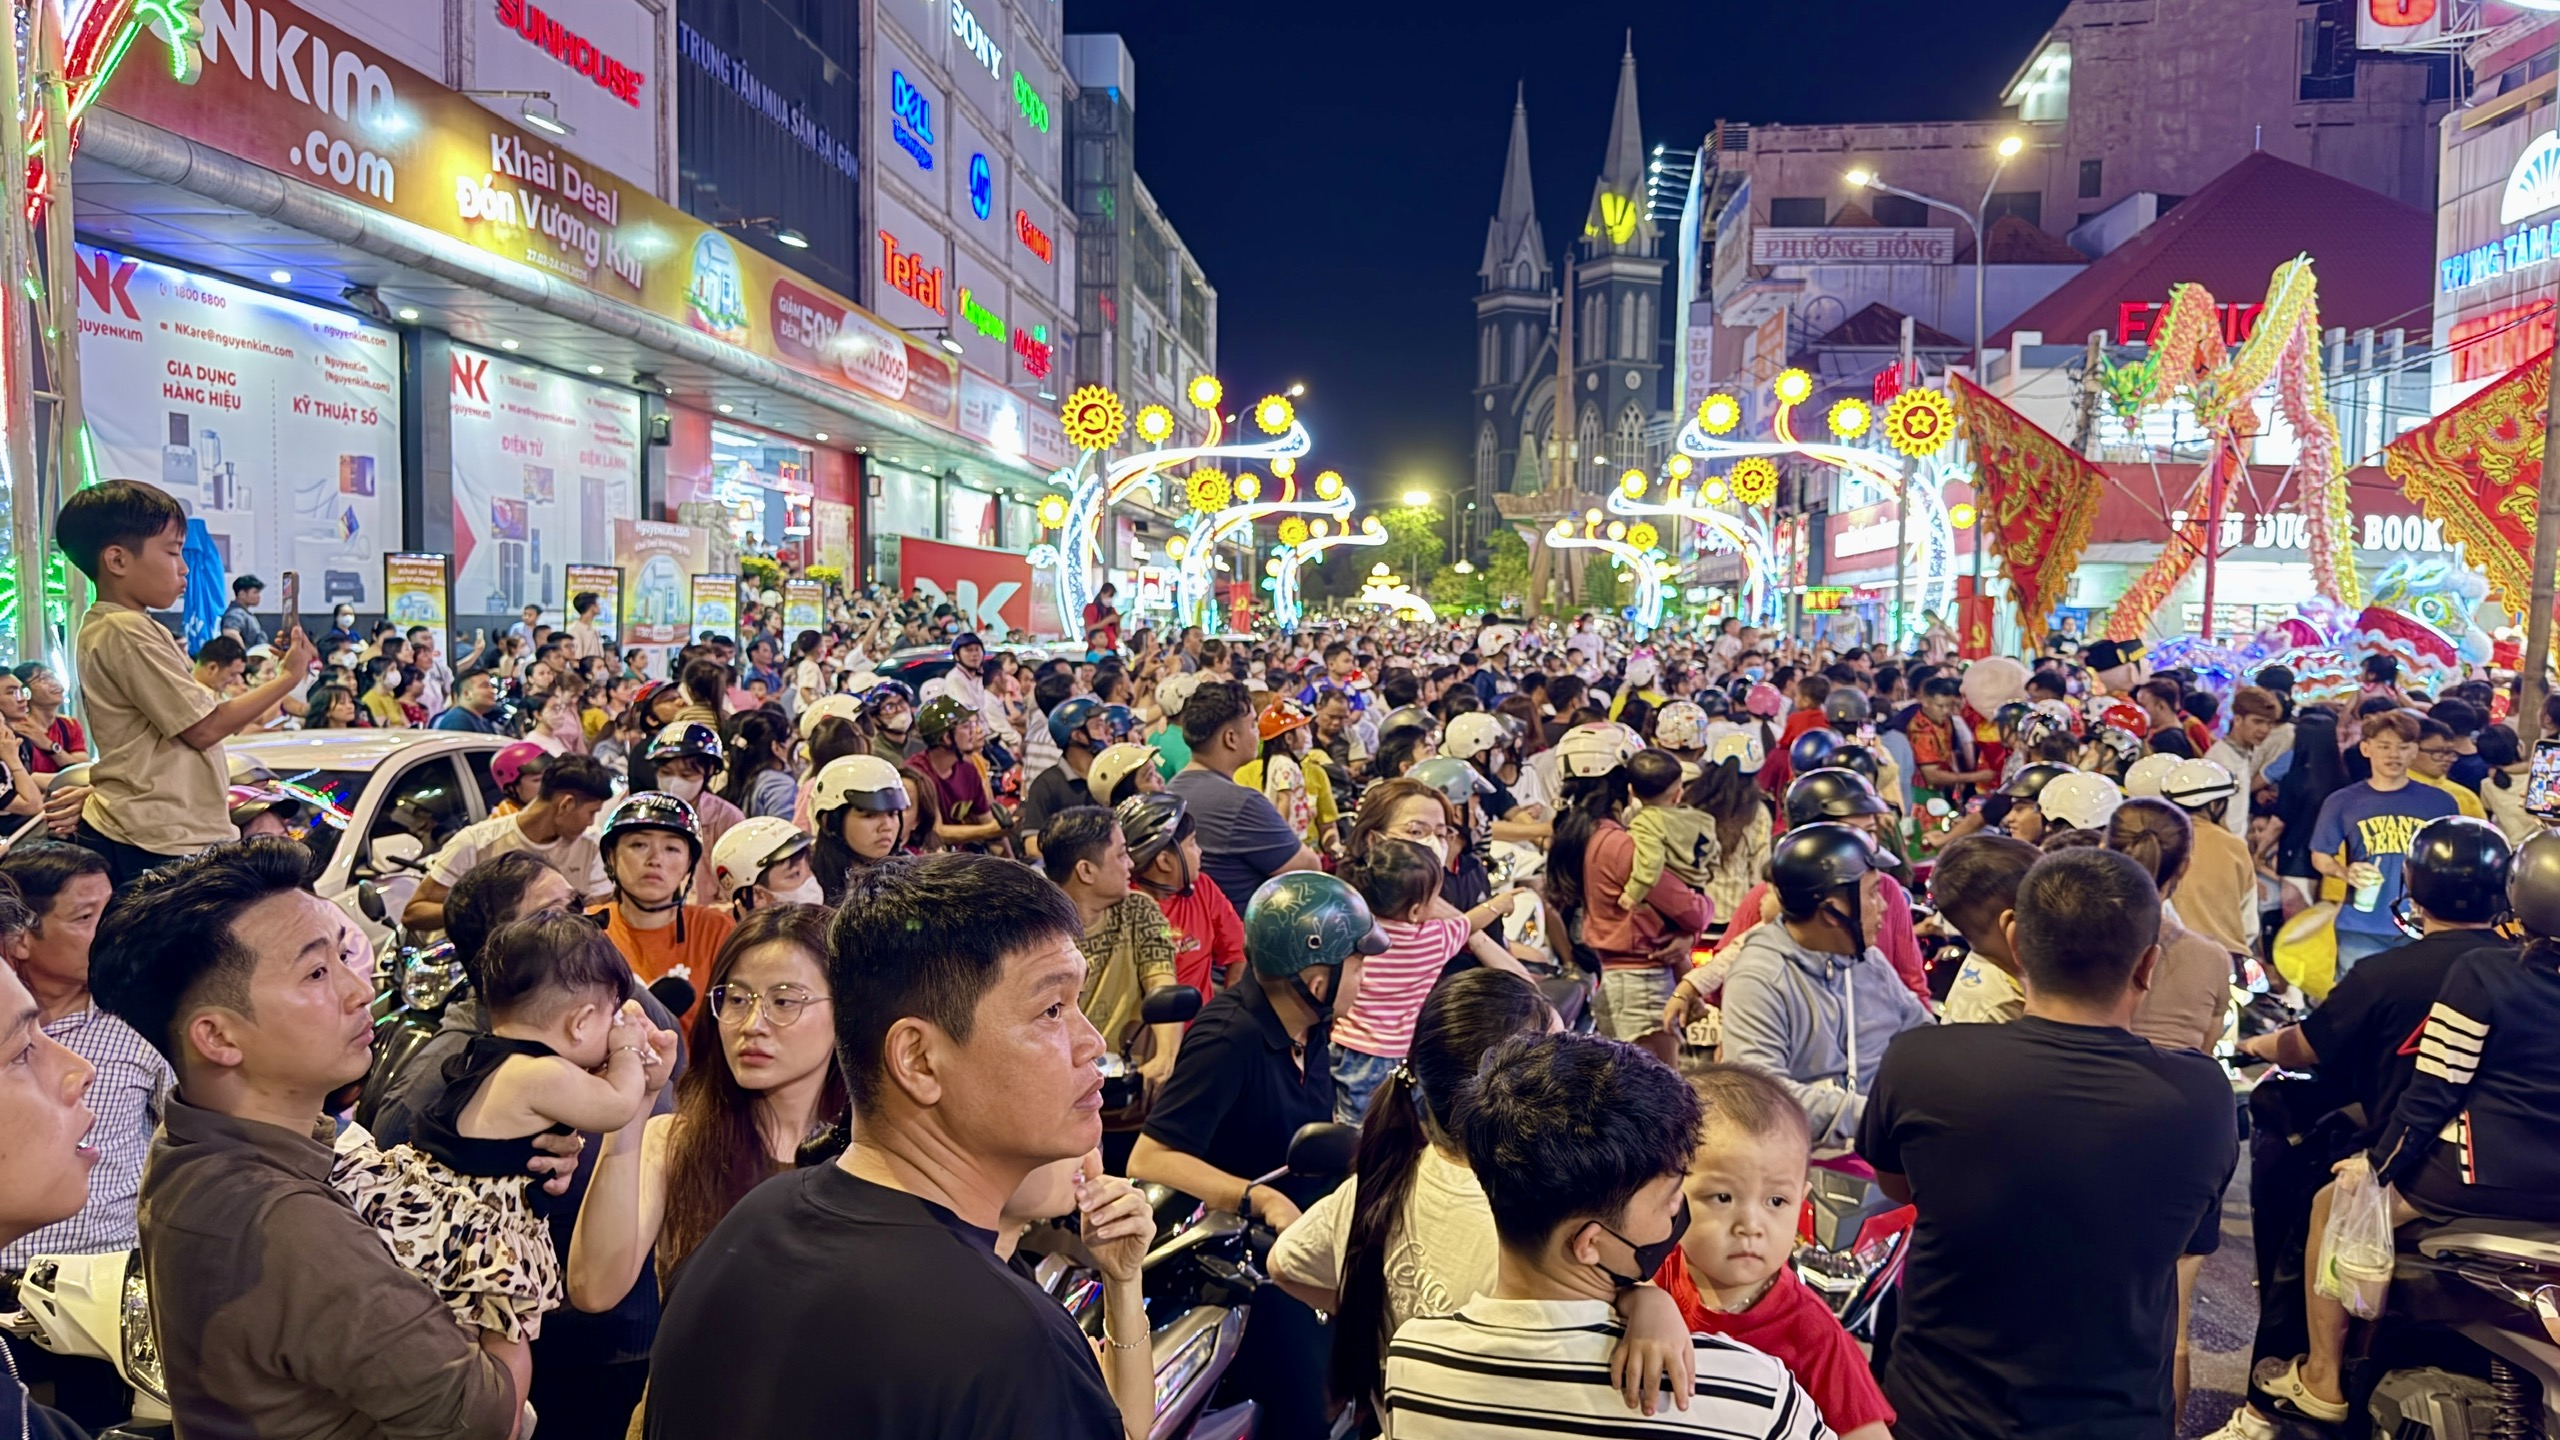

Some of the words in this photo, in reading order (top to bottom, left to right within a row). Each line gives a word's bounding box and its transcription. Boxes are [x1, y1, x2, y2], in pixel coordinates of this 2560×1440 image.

[679, 20, 730, 84] TRUNG
[732, 59, 760, 109] TÂM
[762, 84, 789, 131] MUA
[952, 0, 1002, 80] SONY
[290, 130, 394, 203] .com
[490, 133, 556, 190] Khai
[562, 162, 618, 226] Deal
[456, 174, 517, 225] Đón
[518, 189, 600, 268] Vượng
[2503, 222, 2549, 273] TÂM
[74, 251, 142, 322] NK
[174, 285, 199, 301] 1800
[201, 292, 226, 308] 6800
[879, 229, 946, 317] Tefal
[163, 381, 205, 404] HÀNG
[208, 387, 242, 411] HIỆU
[167, 360, 193, 380] GIA
[196, 365, 237, 387] DỤNG
[293, 392, 311, 414] KỸ
[314, 400, 357, 425] THUẬT
[361, 406, 378, 425] SỐ
[502, 434, 527, 456] ĐIỆN
